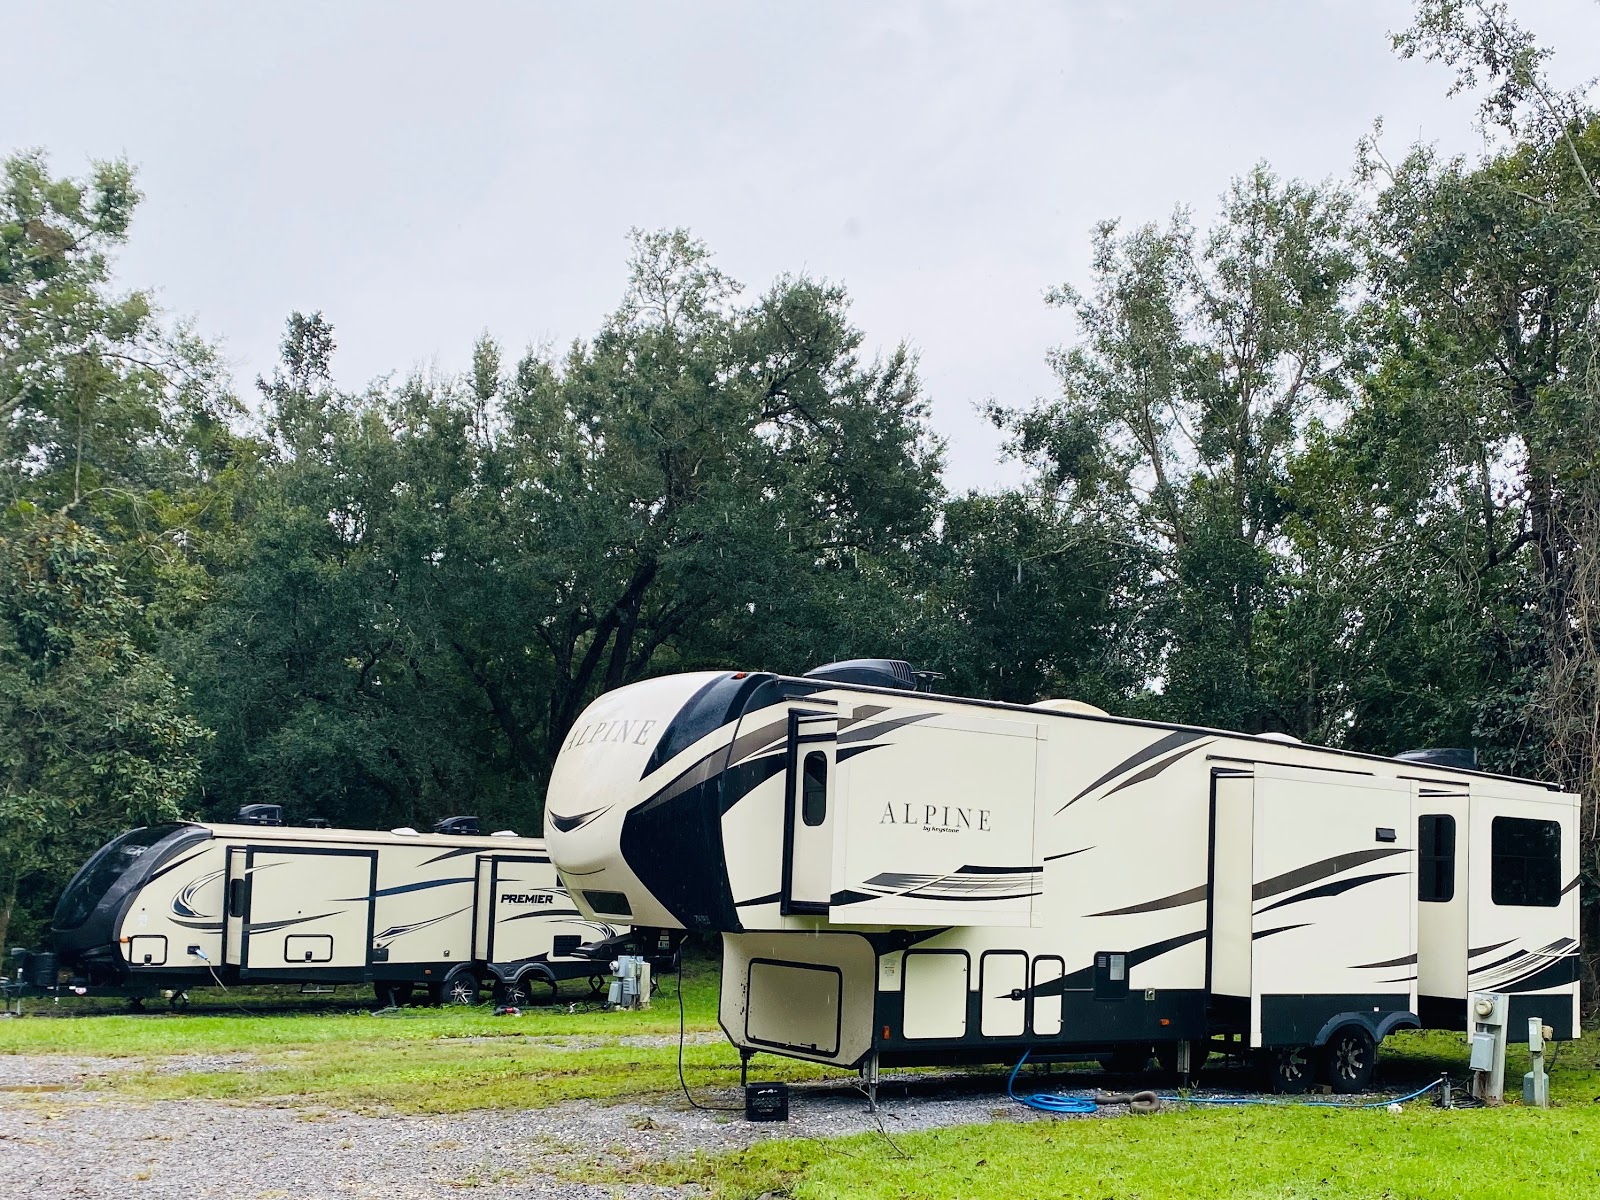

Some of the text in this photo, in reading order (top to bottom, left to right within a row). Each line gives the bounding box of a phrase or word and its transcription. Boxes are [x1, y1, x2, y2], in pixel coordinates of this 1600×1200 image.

[562, 719, 657, 753] ALPINE
[879, 800, 991, 832] ALPINE
[922, 825, 960, 834] by Keystone
[500, 894, 553, 904] PREMIER
